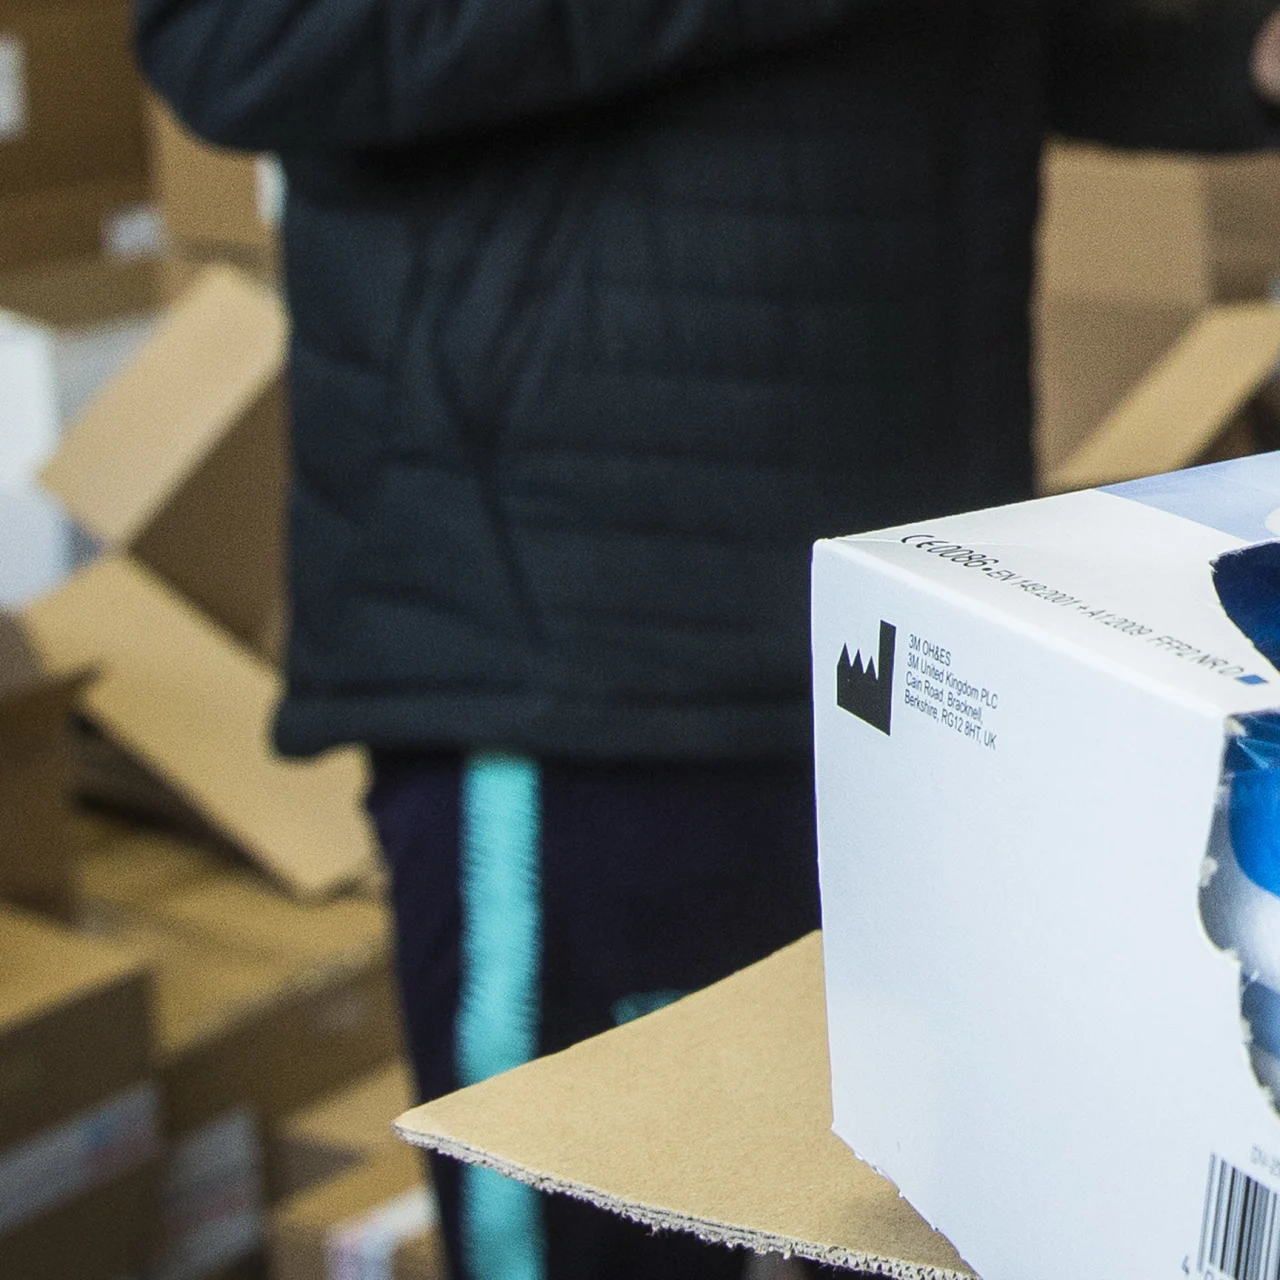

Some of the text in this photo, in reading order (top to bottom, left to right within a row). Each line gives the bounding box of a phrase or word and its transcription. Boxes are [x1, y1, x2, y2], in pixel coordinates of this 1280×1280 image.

[908, 633, 952, 667] 3M OH&ES
[905, 671, 923, 692] Cain
[907, 652, 998, 710] 3M United Kingdom PLC
[941, 708, 964, 733] RG12
[983, 730, 998, 751] UK
